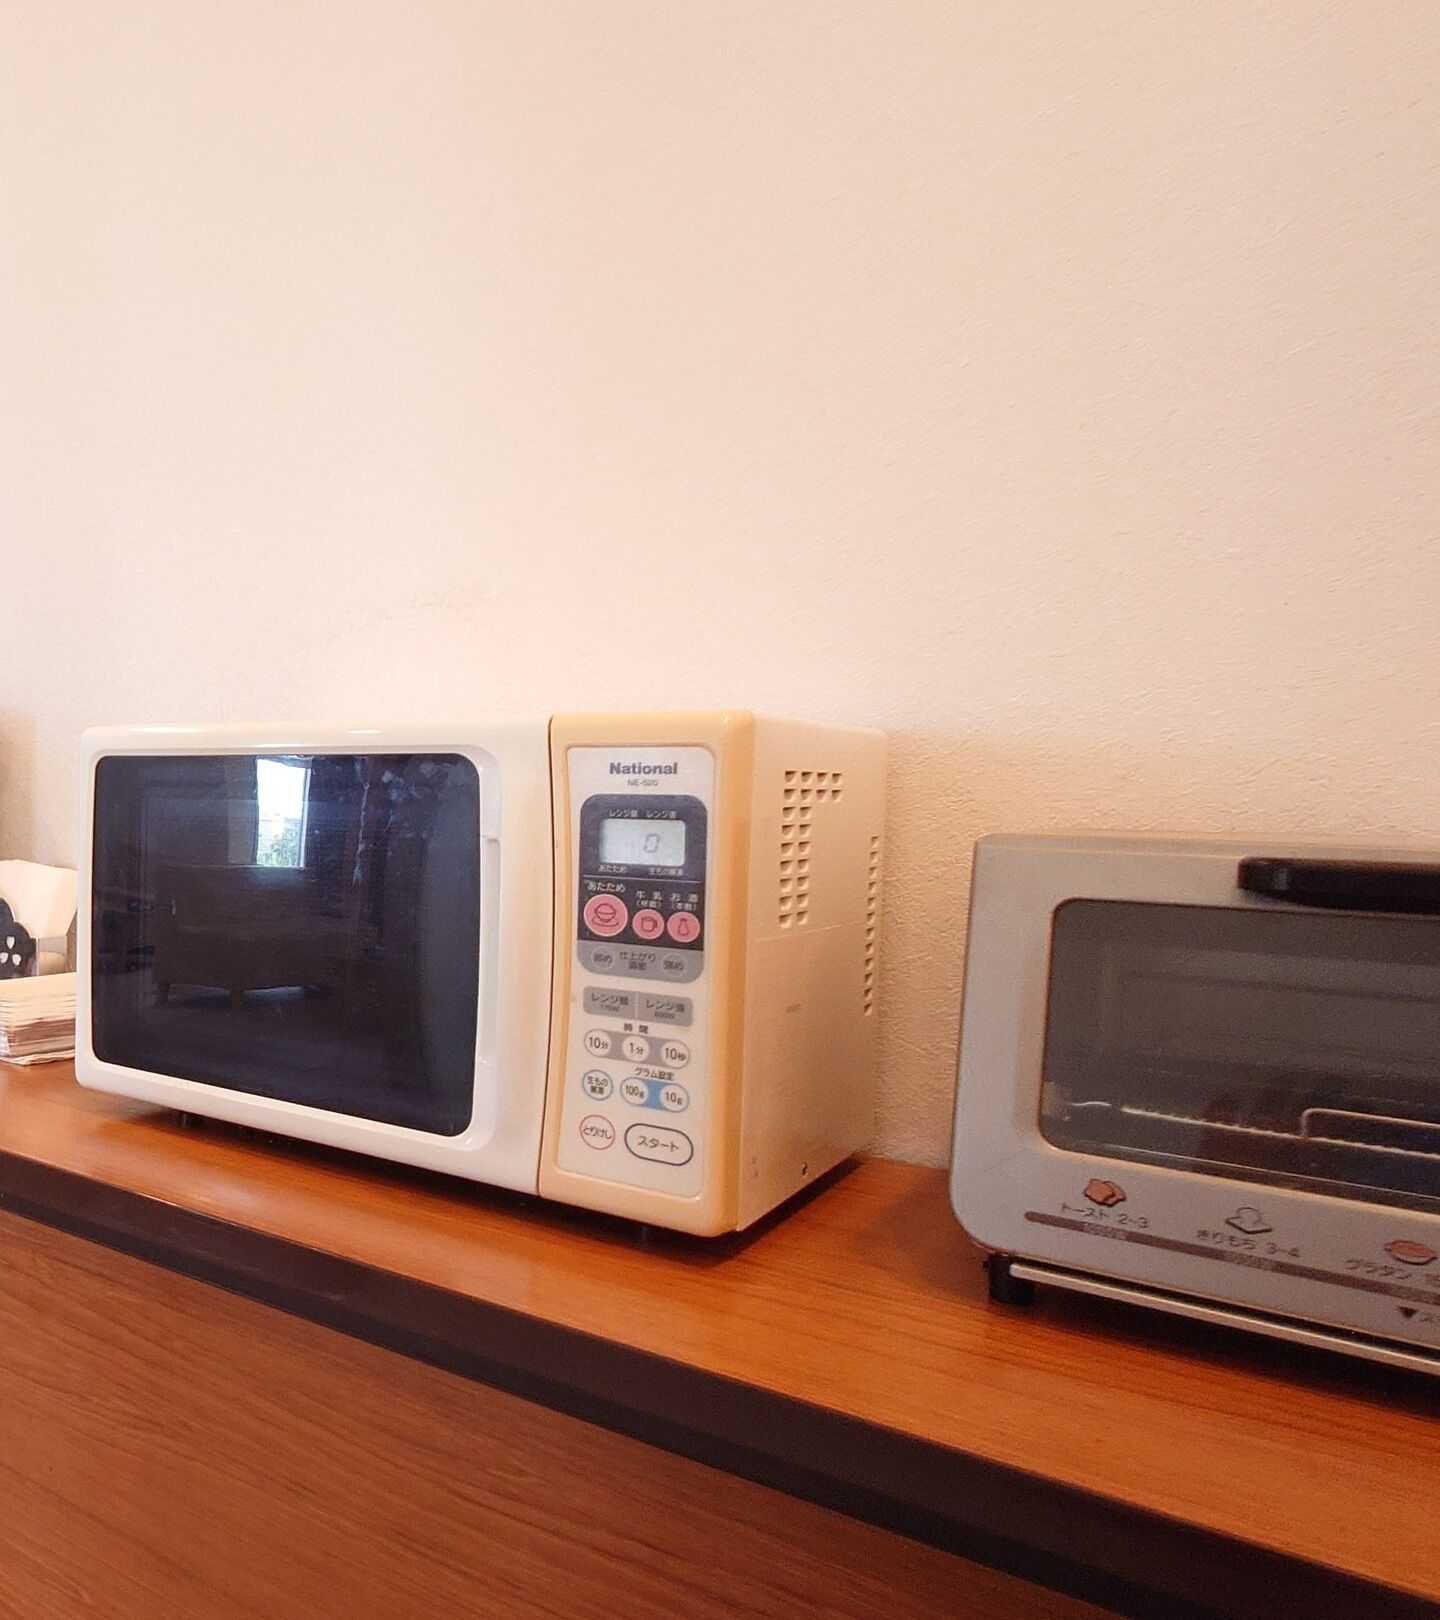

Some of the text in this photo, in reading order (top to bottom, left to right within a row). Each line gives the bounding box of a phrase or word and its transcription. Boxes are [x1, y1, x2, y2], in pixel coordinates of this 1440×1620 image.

[609, 762, 678, 775] National
[598, 864, 627, 874] あたため
[587, 881, 626, 893] あたため
[620, 951, 656, 963] 仕上がり
[588, 1036, 609, 1050] 10分
[629, 1042, 644, 1055] 1分
[634, 1067, 675, 1081] グラム設定
[582, 1125, 612, 1140] とりけし
[637, 1135, 680, 1153] スタート
[1062, 1201, 1111, 1220] トースト
[1196, 1229, 1258, 1250] きりもち
